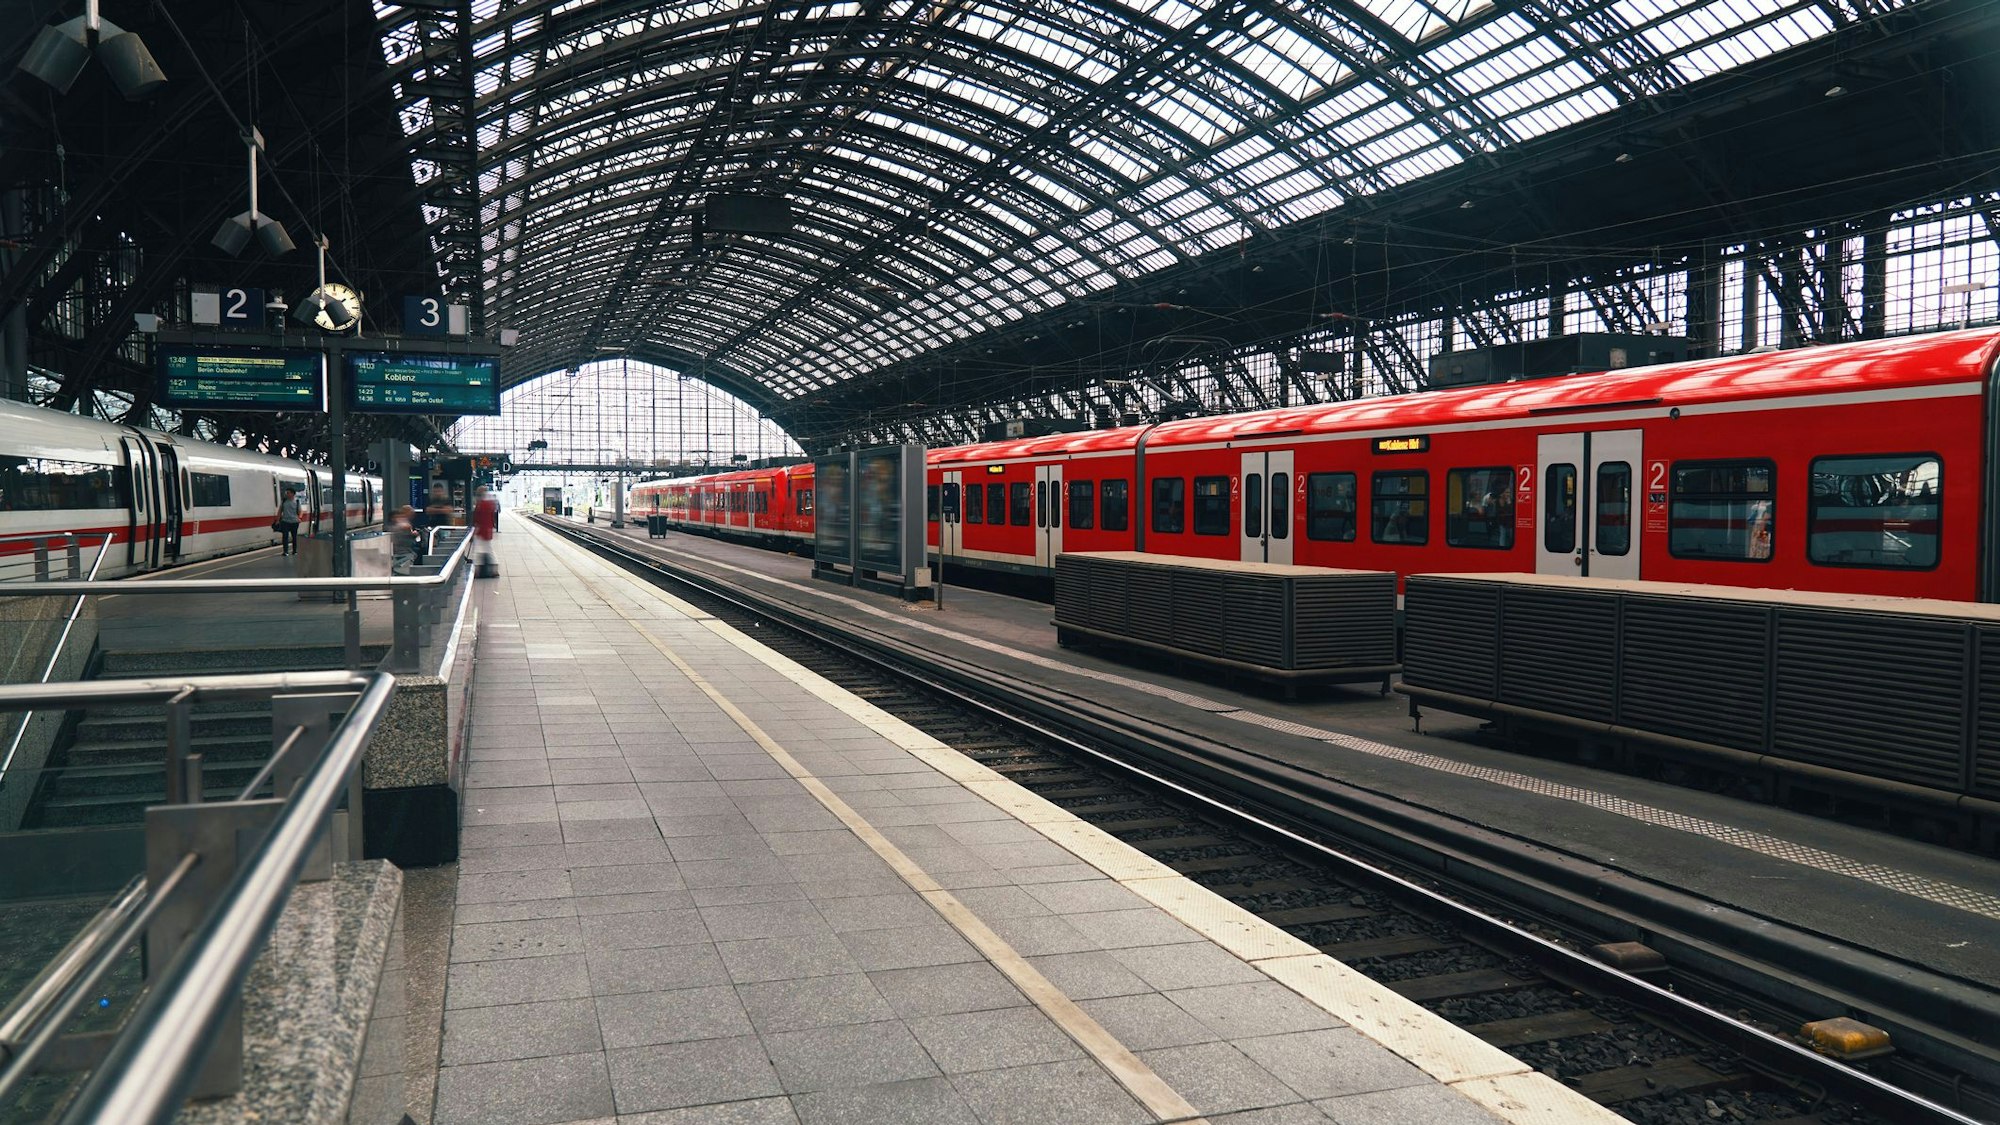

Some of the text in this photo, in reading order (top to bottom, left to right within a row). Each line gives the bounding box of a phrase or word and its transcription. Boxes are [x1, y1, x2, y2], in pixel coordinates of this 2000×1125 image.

[226, 288, 248, 319] 2
[420, 298, 440, 327] 3
[384, 373, 416, 382] Koblenz
[502, 462, 511, 473] D
[1650, 461, 1665, 490] 2
[1231, 477, 1238, 494] 2
[1297, 475, 1305, 493] 2
[1519, 466, 1531, 492] 2
